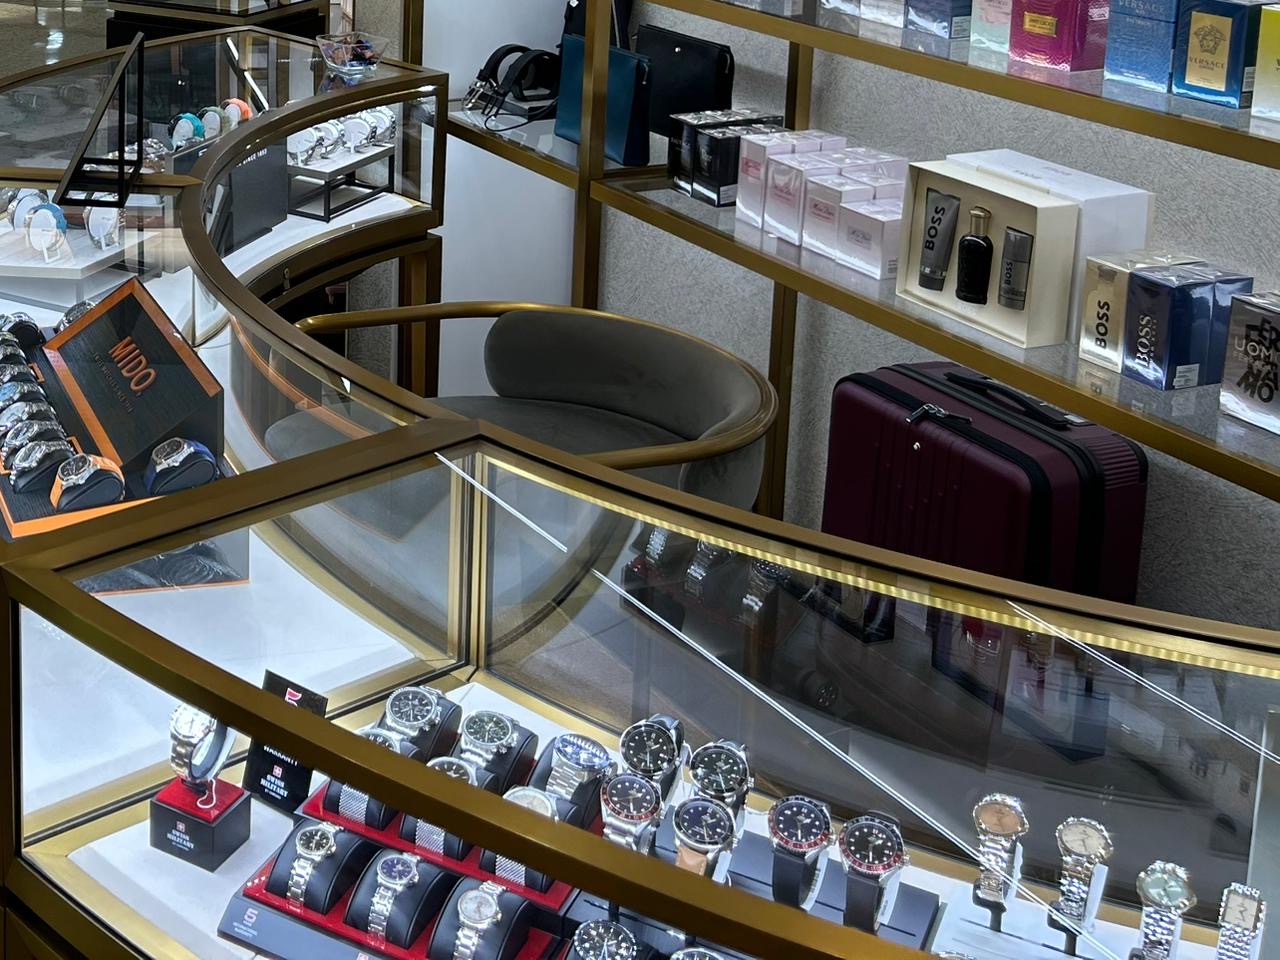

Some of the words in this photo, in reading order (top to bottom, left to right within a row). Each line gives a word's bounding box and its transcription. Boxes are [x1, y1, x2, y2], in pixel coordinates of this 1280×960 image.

[1189, 56, 1225, 70] VERSACE
[925, 206, 946, 251] BOSS
[1004, 261, 1014, 286] BOSS
[1095, 300, 1111, 350] BOSS
[1135, 314, 1152, 367] BOSS
[1234, 335, 1280, 362] UOM
[108, 336, 158, 393] MIDO
[260, 777, 289, 797] MILITARY
[266, 773, 285, 788] SWISS
